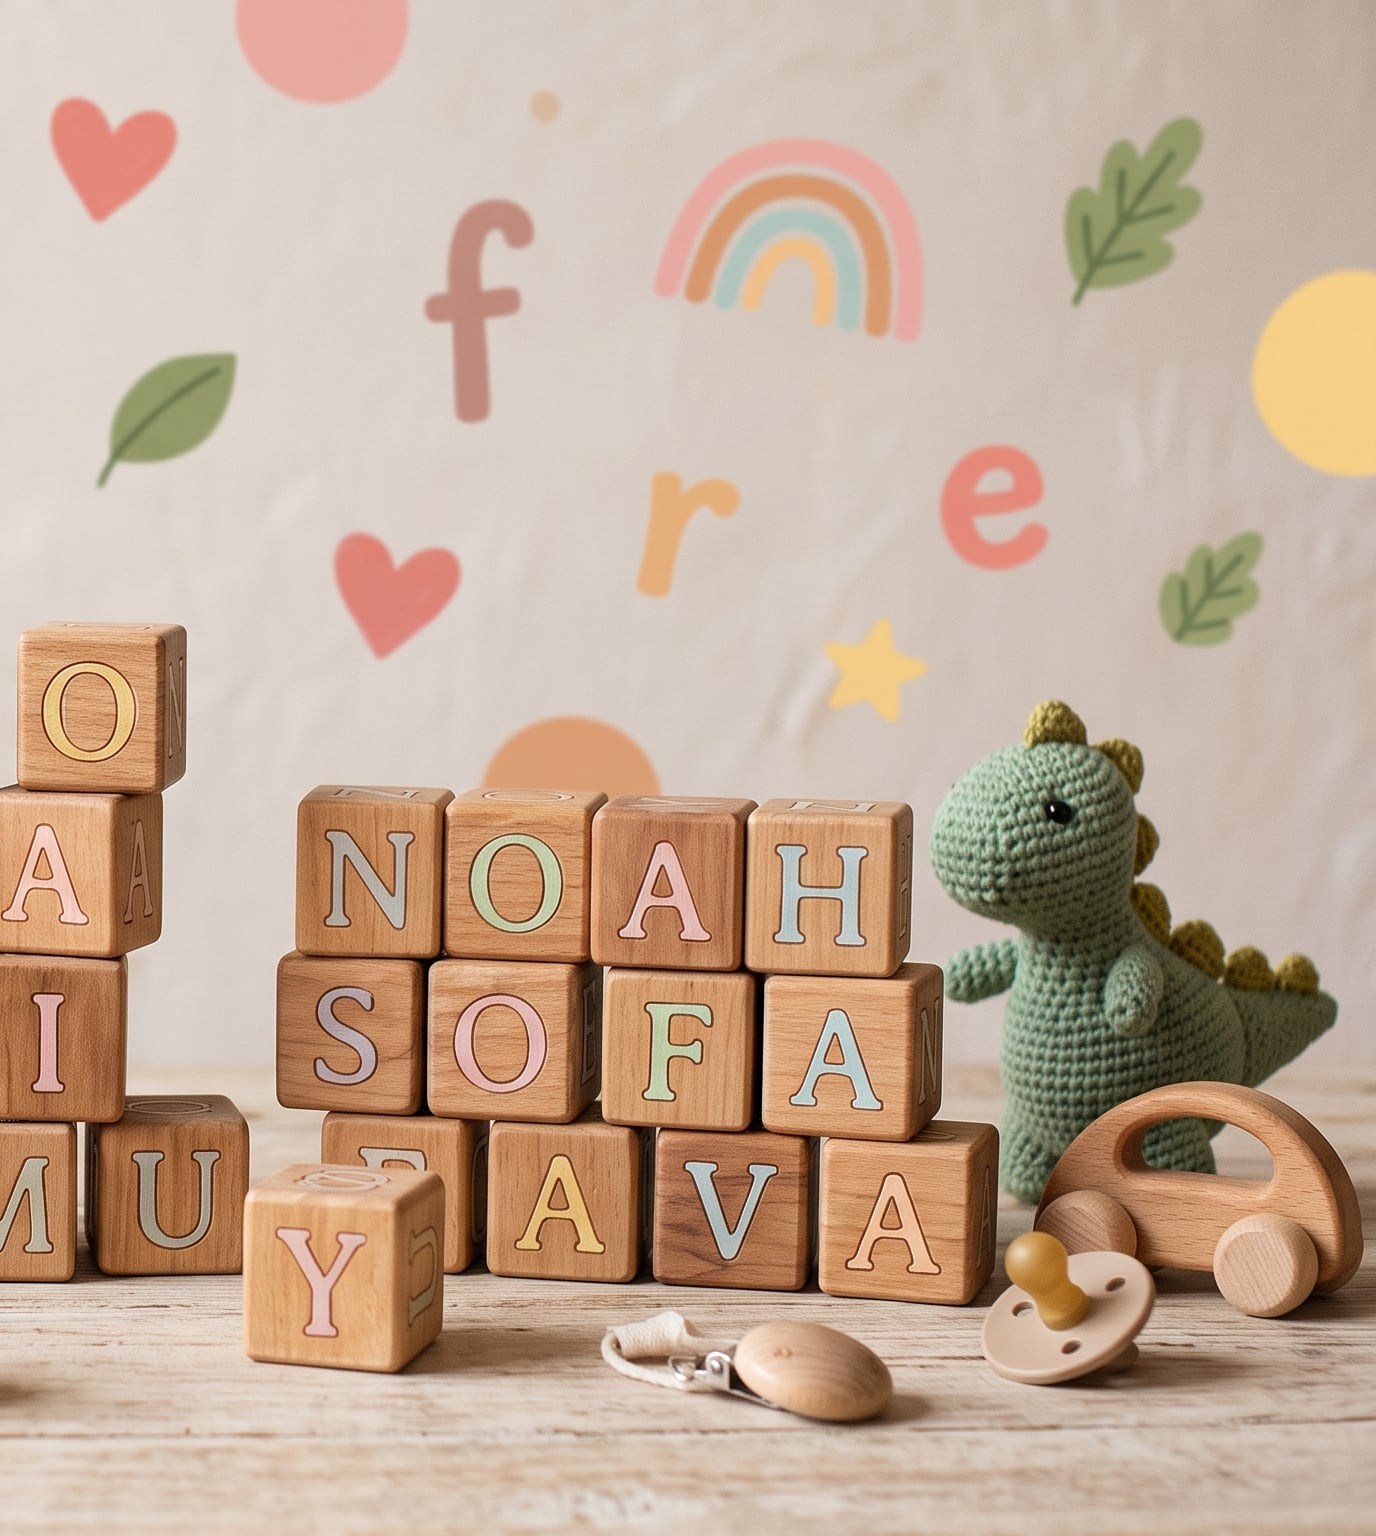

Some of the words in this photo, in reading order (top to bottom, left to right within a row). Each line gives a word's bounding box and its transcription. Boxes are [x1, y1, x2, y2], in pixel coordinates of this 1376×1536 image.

[424, 198, 535, 424] f
[636, 471, 740, 598] r
[940, 444, 1049, 571] e
[324, 828, 870, 947] NOAH
[514, 1153, 942, 1275] AVA
[275, 1226, 368, 1338] Y
